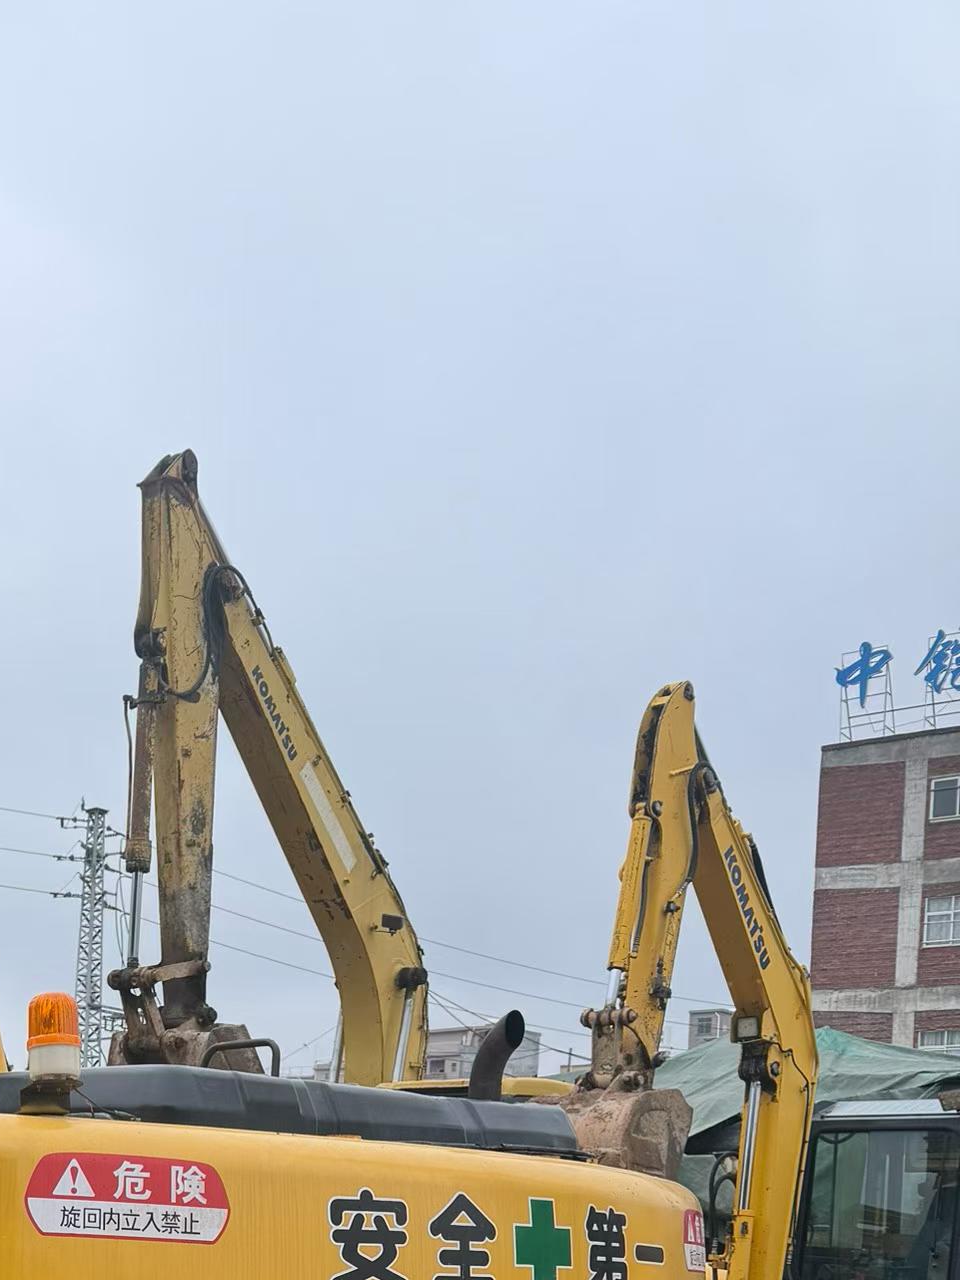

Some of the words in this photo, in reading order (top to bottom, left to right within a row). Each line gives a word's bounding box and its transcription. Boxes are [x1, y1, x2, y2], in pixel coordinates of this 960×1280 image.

[252, 665, 297, 761] KOMATSU
[723, 844, 771, 970] KOMATSU
[113, 1160, 208, 1205] 危険
[60, 1205, 201, 1236] 旋回内立入禁止
